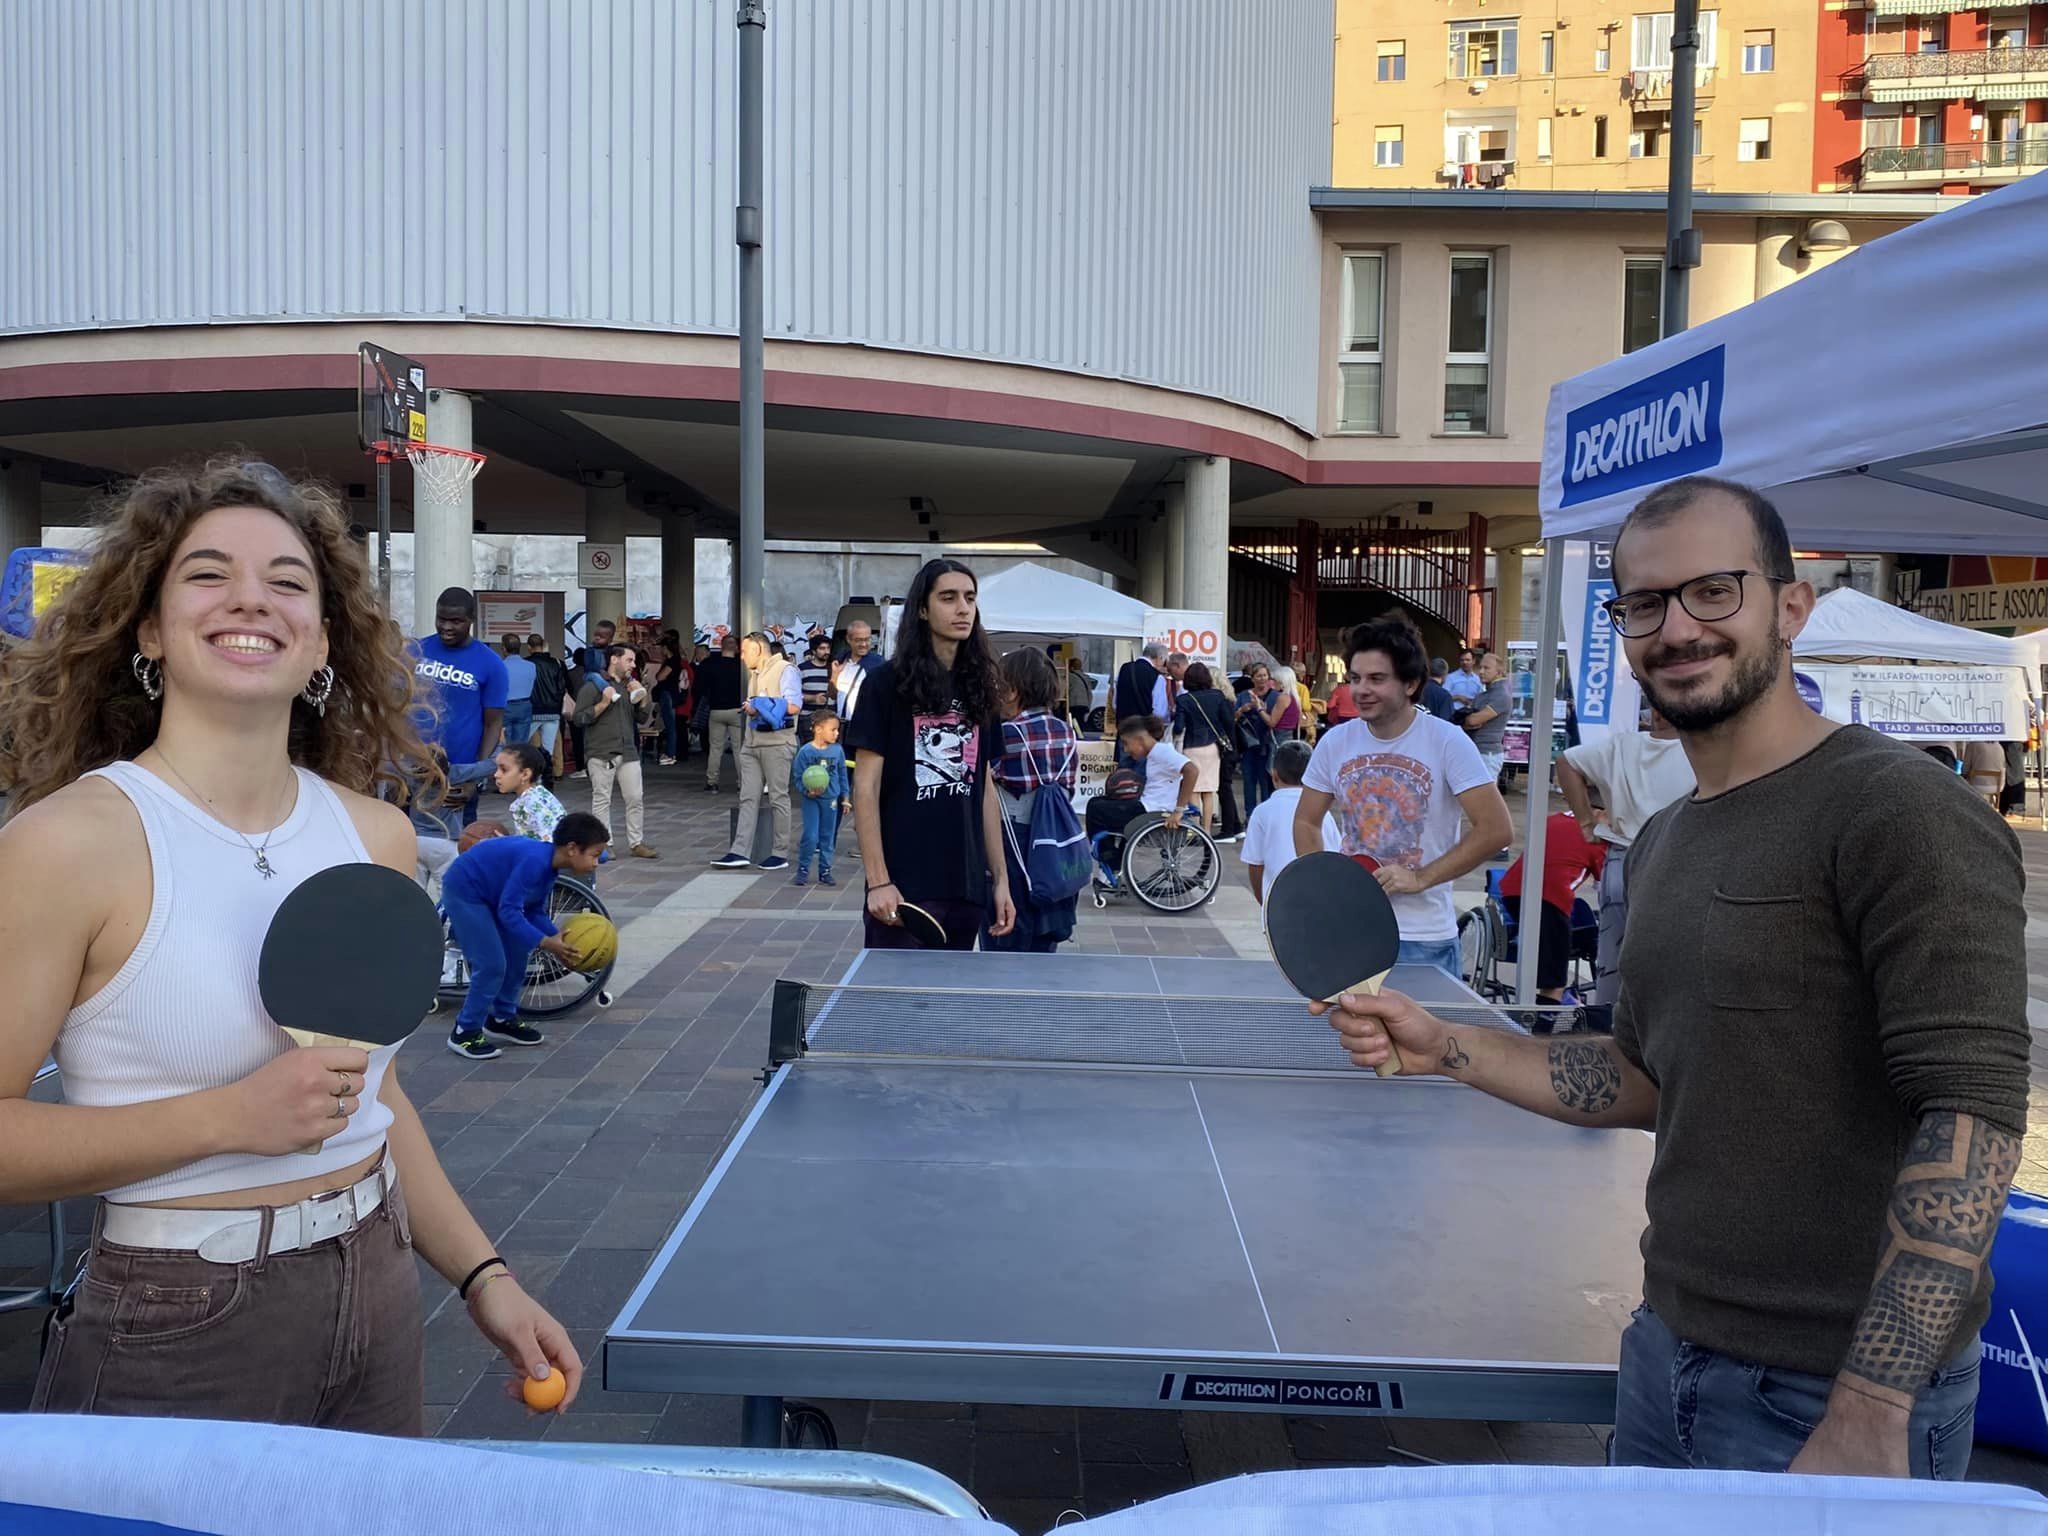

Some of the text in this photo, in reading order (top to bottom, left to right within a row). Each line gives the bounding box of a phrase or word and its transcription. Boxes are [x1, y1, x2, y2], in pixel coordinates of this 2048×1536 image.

[1571, 380, 1710, 483] DECATHLON
[1960, 591, 1998, 621] DELLE
[1167, 629, 1217, 655] 100
[415, 660, 475, 686] adidas
[1852, 671, 2004, 682] WWW.ILFAROMETROPOLITANO.IT
[1885, 723, 1911, 733] FARO
[1915, 723, 2002, 734] METROPOLITANO
[1080, 775, 1091, 785] DI
[916, 785, 942, 801] EAT
[1195, 1381, 1372, 1402] DECATHLON PONGORI
